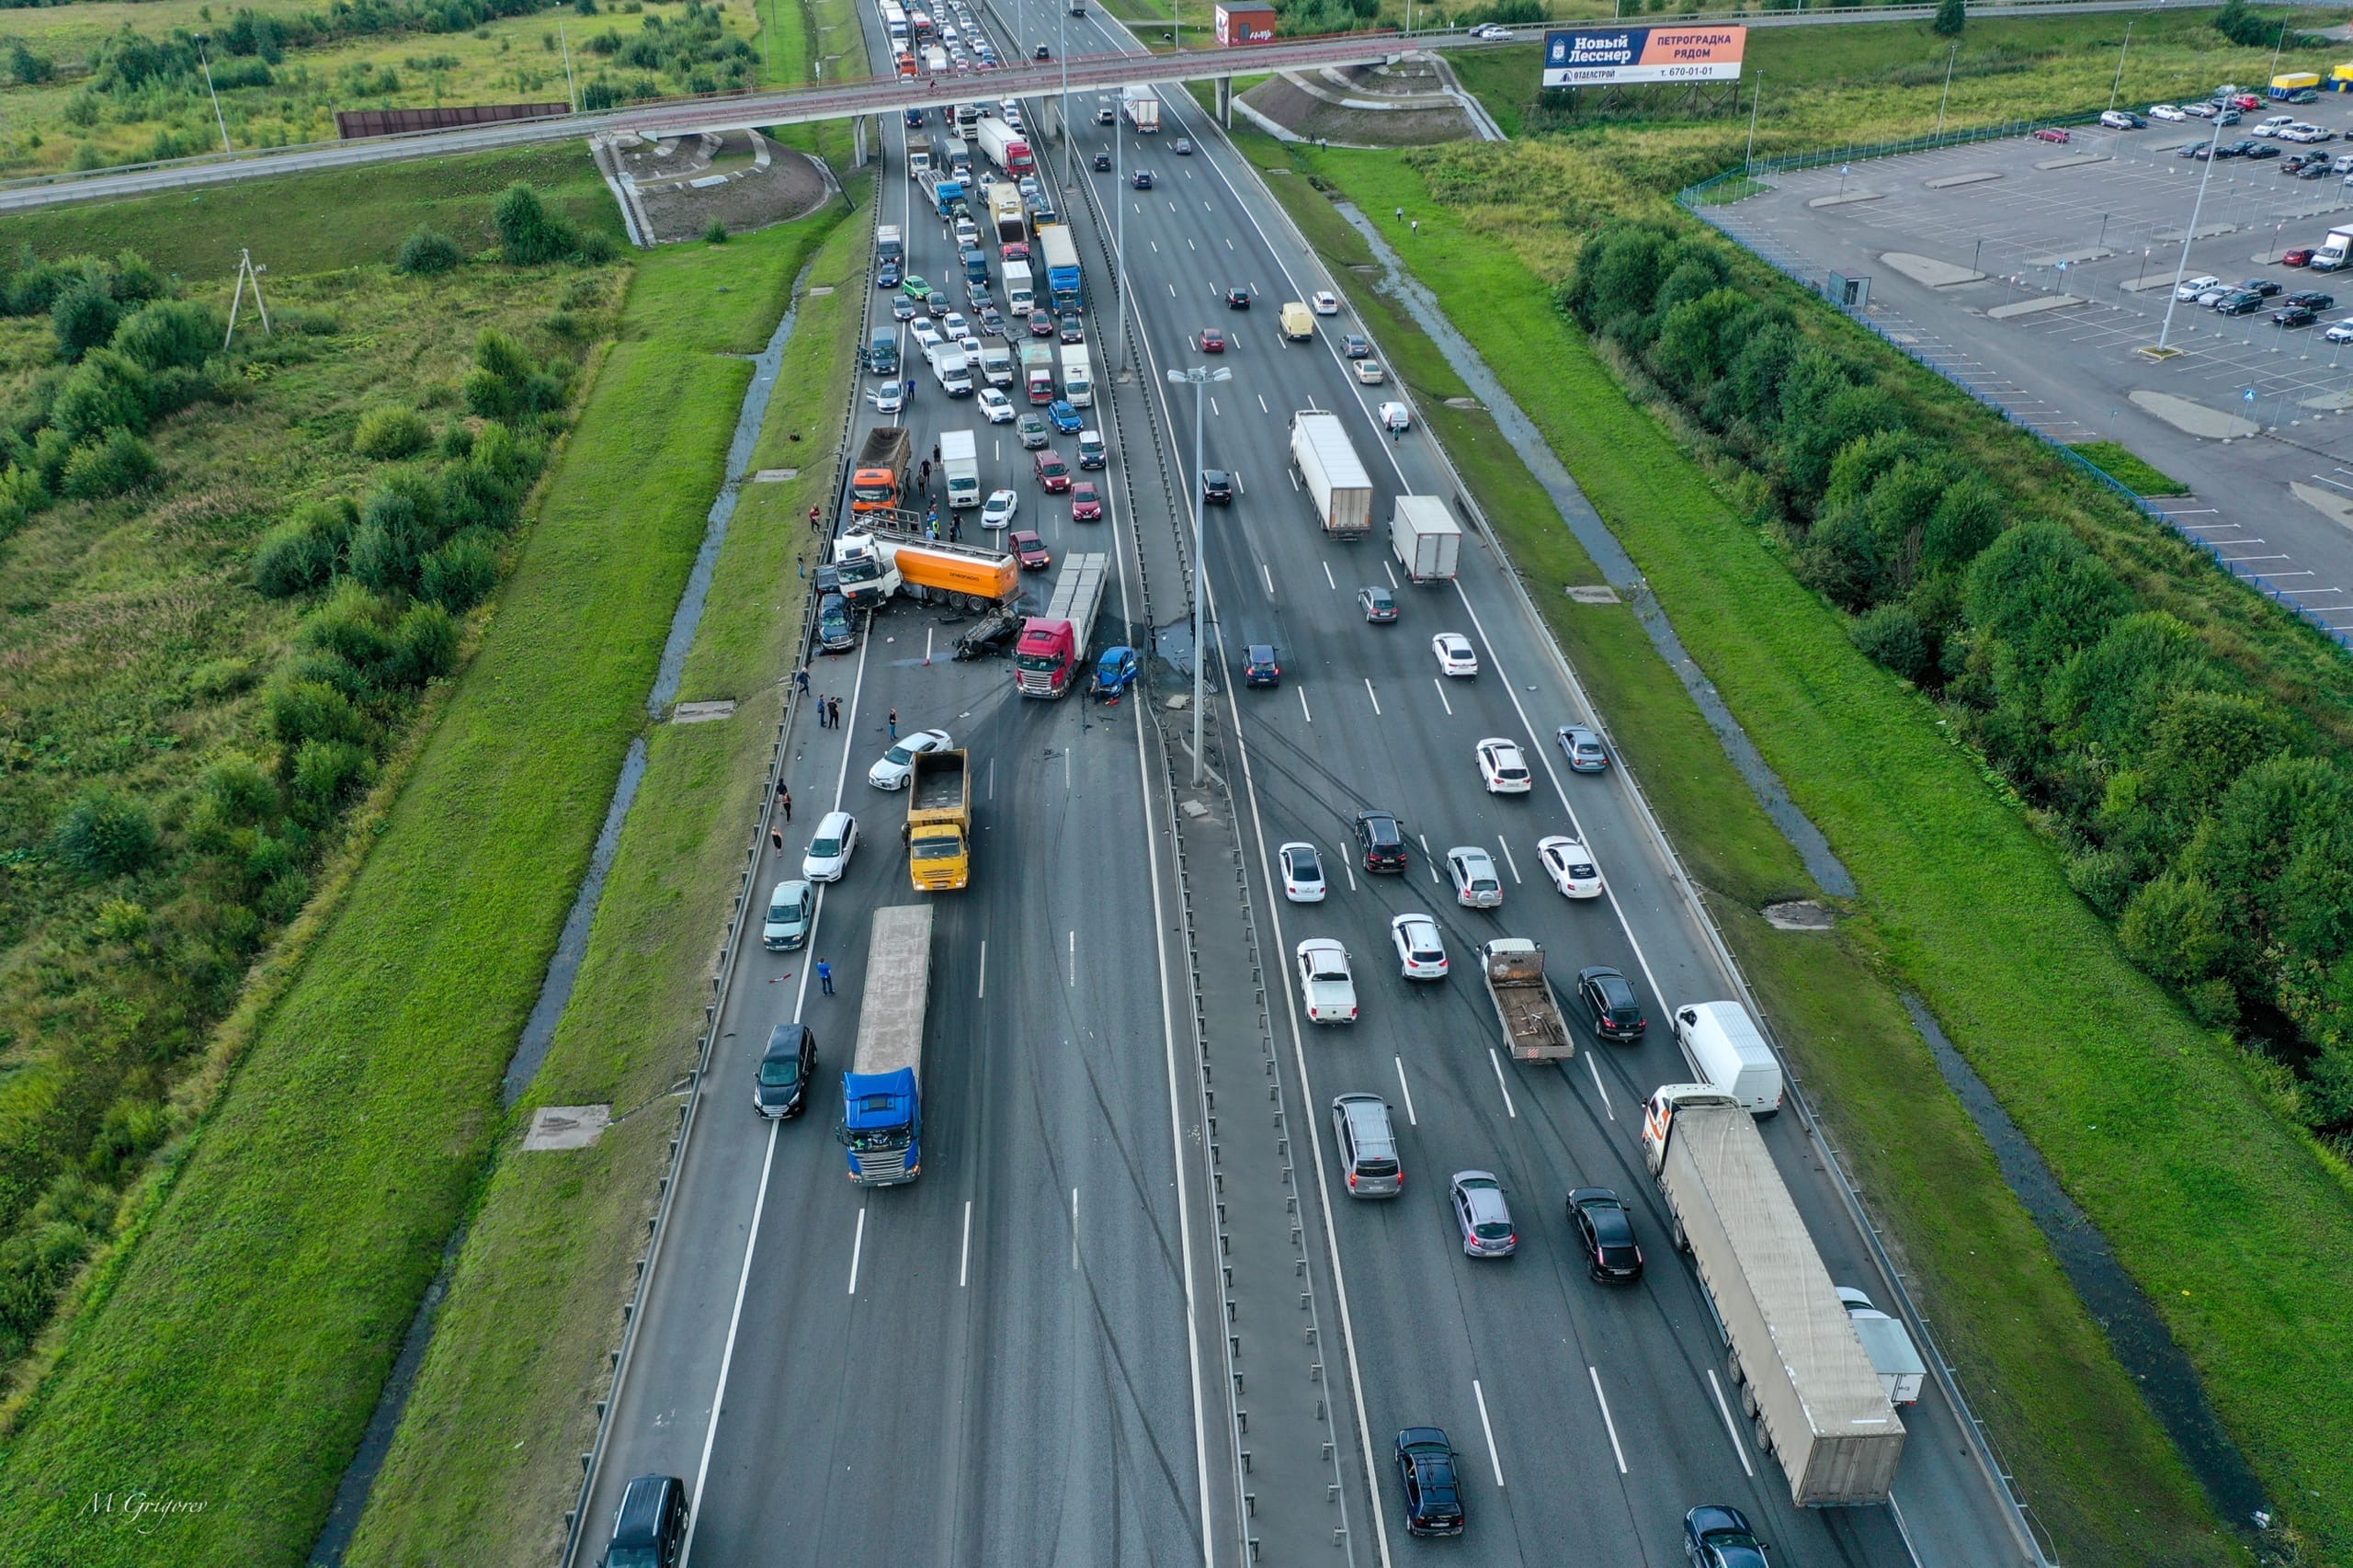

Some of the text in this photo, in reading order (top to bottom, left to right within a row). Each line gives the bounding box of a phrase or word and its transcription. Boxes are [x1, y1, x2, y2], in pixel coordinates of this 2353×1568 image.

[1574, 34, 1629, 50] Новый
[1657, 35, 1732, 46] ПЕТРОГРАДКА
[1568, 49, 1631, 64] Лесснер
[1674, 49, 1711, 59] РЯДОМ
[1574, 69, 1616, 80] ОТДЕЛСТРОЙ
[1669, 66, 1712, 76] 670-01-01
